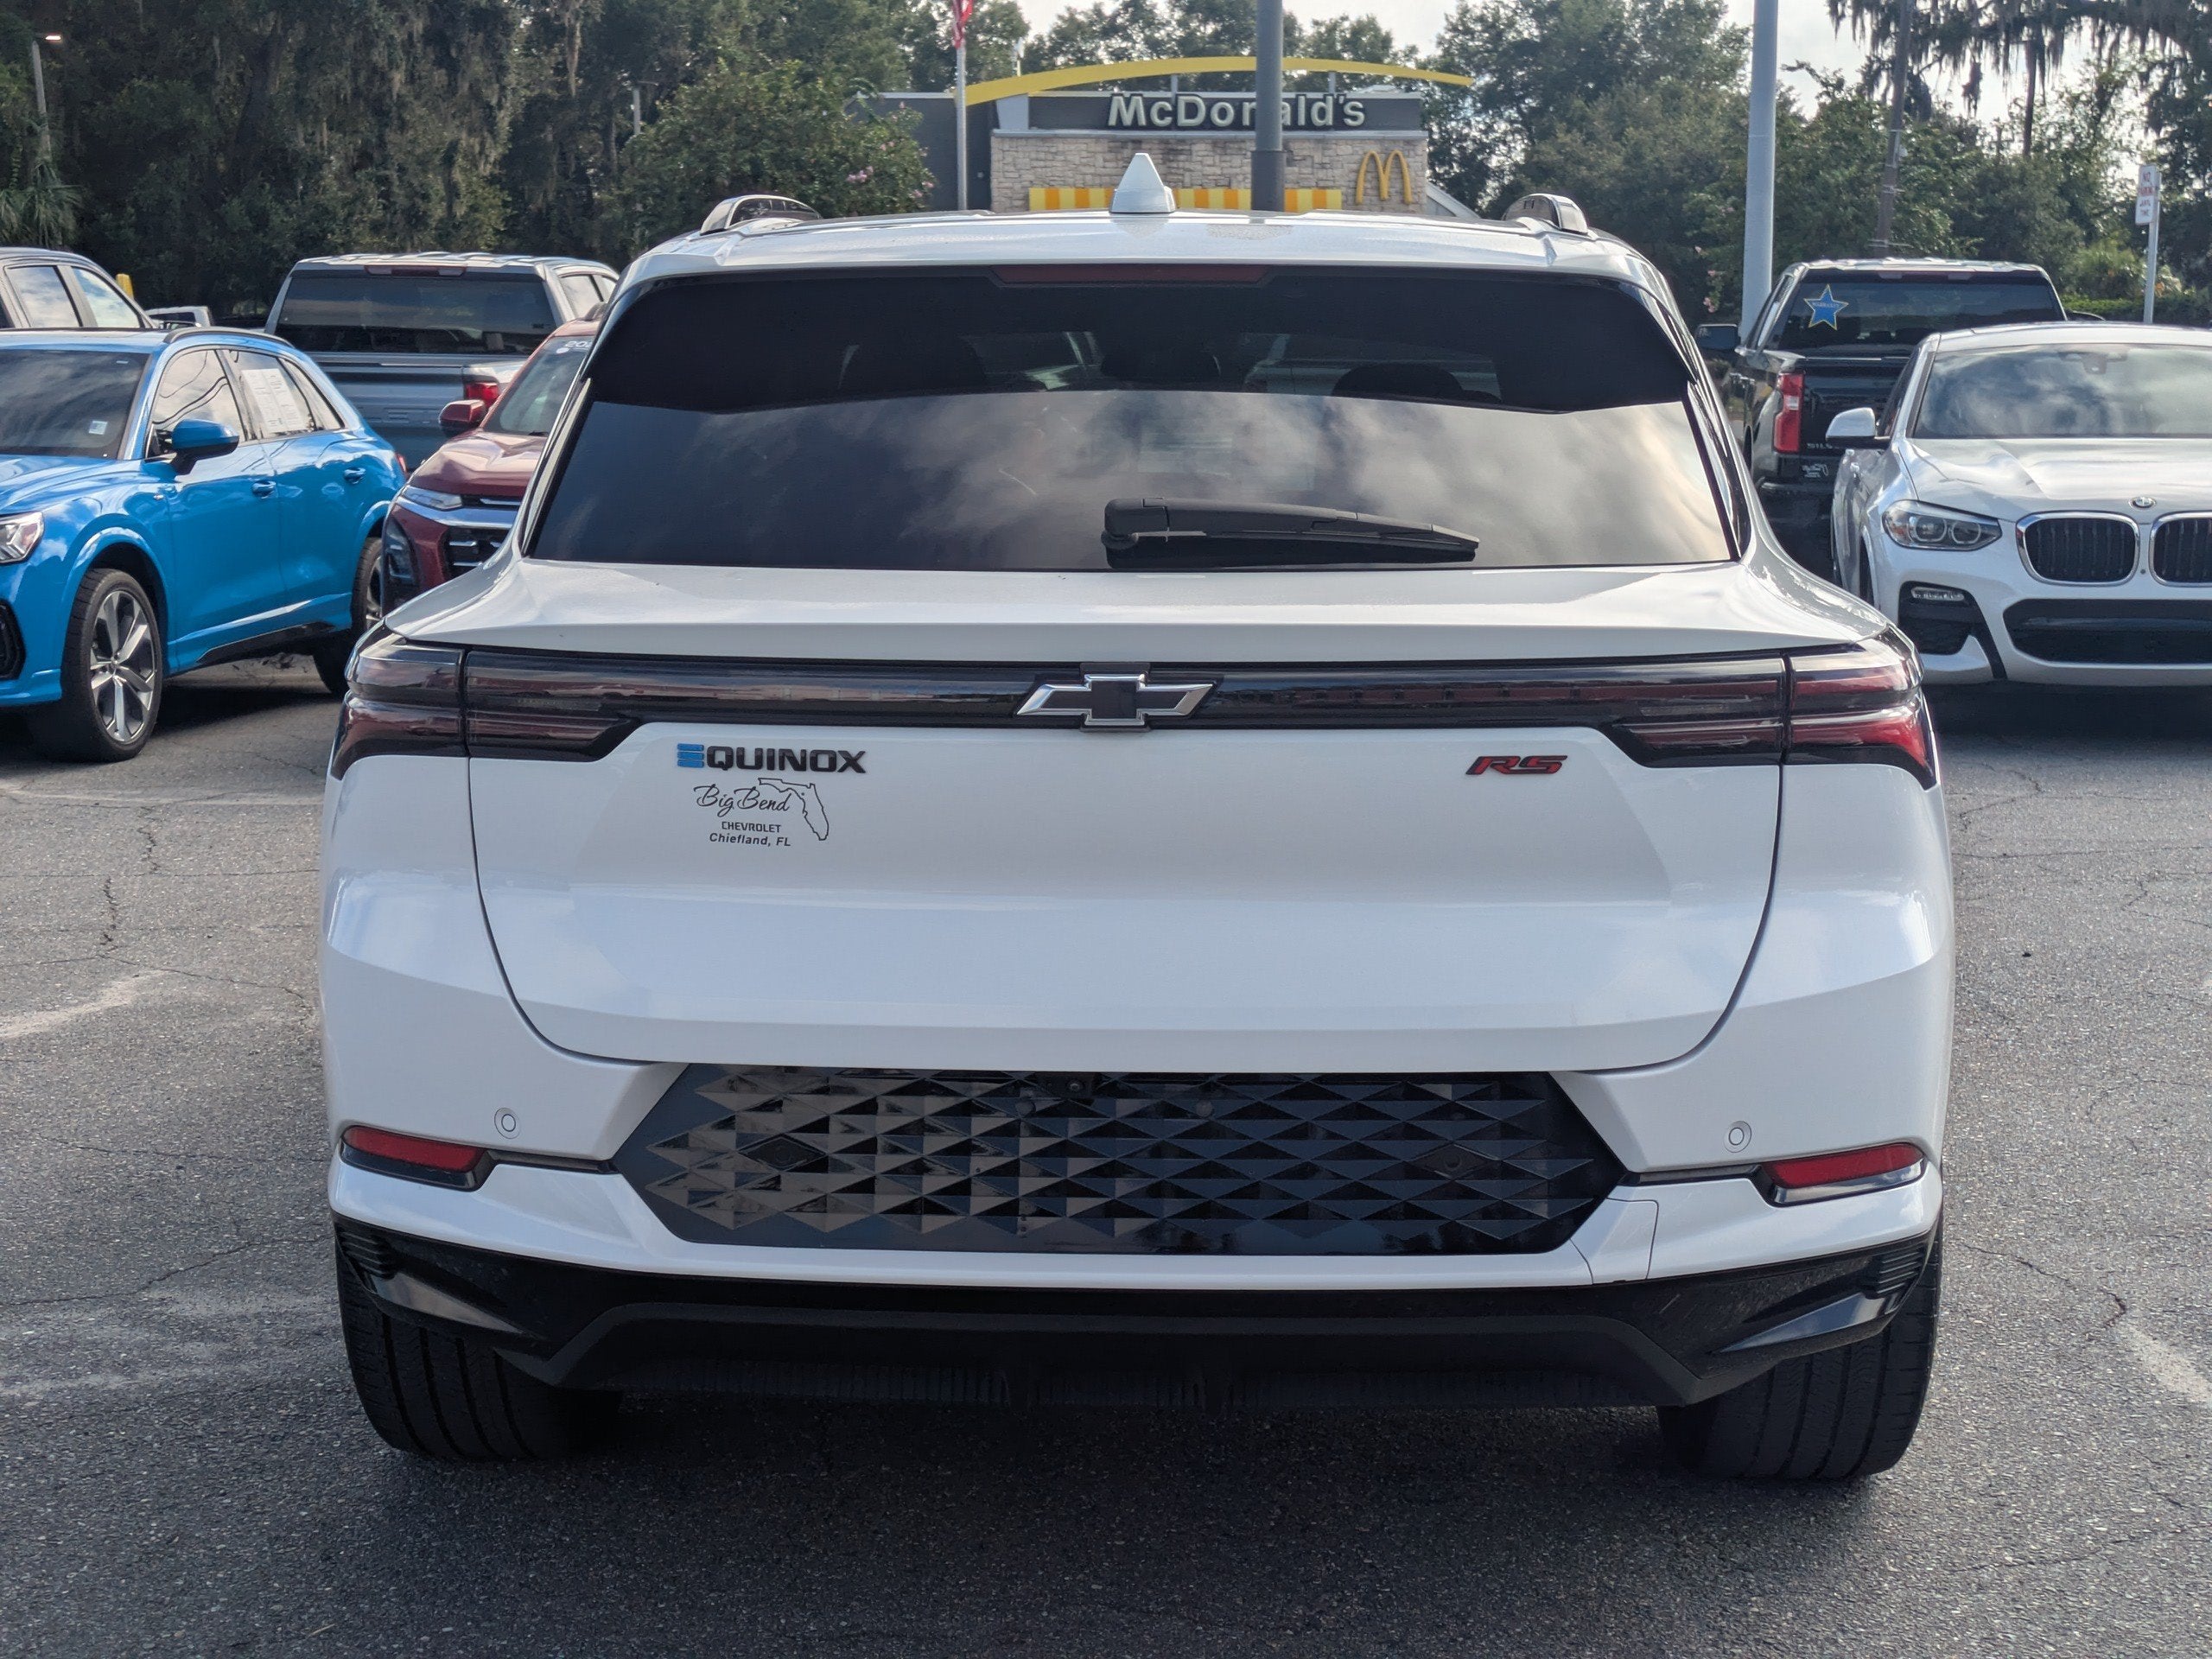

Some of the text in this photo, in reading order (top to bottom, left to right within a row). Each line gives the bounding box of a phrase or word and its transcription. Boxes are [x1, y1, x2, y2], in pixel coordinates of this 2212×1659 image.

[677, 743, 866, 774] EQUINOX
[1465, 755, 1568, 775] RS
[693, 783, 792, 817] Big Bend
[721, 821, 781, 833] CHEVROLET
[709, 832, 791, 848] Chiefland, FL
